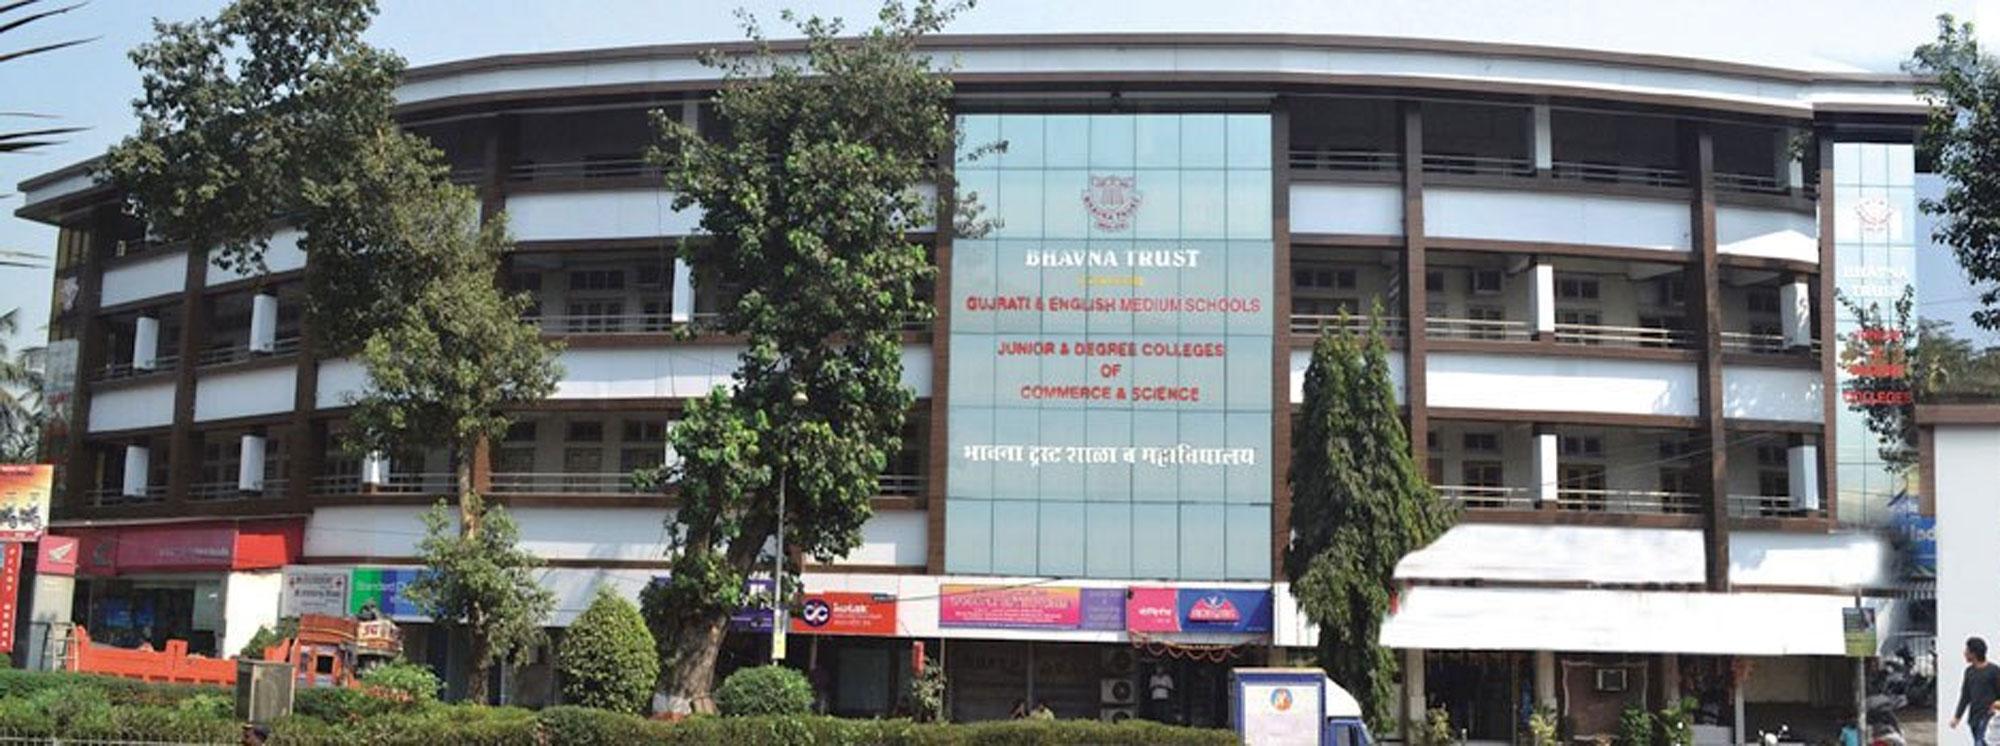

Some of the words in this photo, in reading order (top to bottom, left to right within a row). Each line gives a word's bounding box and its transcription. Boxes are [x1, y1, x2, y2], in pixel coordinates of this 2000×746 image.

[1025, 249, 1118, 267] BHAVNA
[1127, 249, 1200, 267] TRUST
[966, 297, 1030, 312] GUJRATI
[1035, 297, 1044, 312] &
[1049, 297, 1116, 312] ENGLISH
[1120, 297, 1181, 312] MEDIUM
[1184, 298, 1261, 313] SCHOOLS
[998, 341, 1055, 356] JUNIOR
[1060, 342, 1069, 356] &
[1074, 342, 1138, 357] DEGREE
[1142, 343, 1226, 357] COLLEGES
[1100, 364, 1122, 378] OF
[1020, 385, 1111, 400] COMMERCE
[1116, 387, 1126, 400] &
[1132, 386, 1200, 401] SCIENCE
